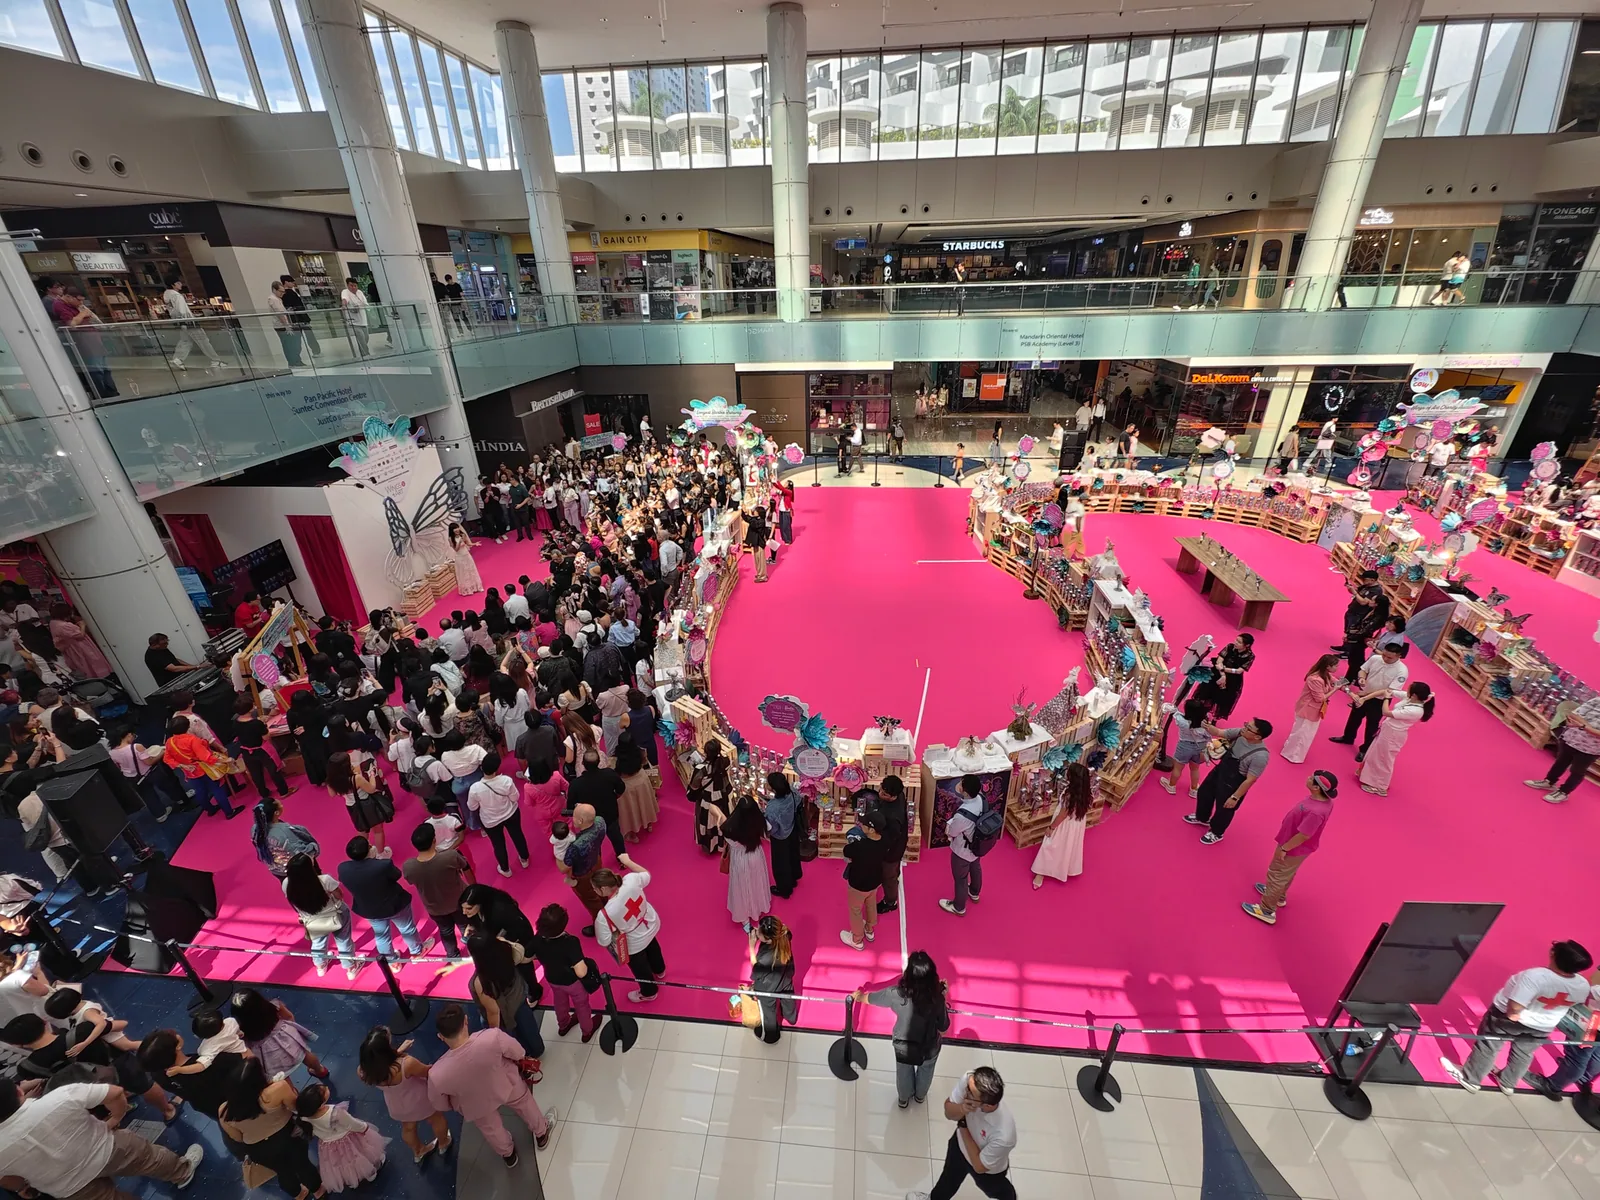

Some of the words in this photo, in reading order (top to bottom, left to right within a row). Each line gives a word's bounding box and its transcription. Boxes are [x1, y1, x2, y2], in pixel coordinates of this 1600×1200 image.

[1541, 207, 1596, 215] STONEAGE
[603, 236, 625, 244] GAIN
[627, 235, 648, 244] CITY
[943, 240, 1004, 250] STARBUCKS
[83, 262, 126, 270] BEAUTIFUL
[304, 395, 316, 403] Pan
[317, 390, 335, 401] Pacific
[336, 386, 353, 397] Hotel
[292, 405, 315, 415] Suntec
[315, 397, 348, 410] Convention
[349, 392, 367, 401] Centre
[317, 414, 337, 425] JustCo
